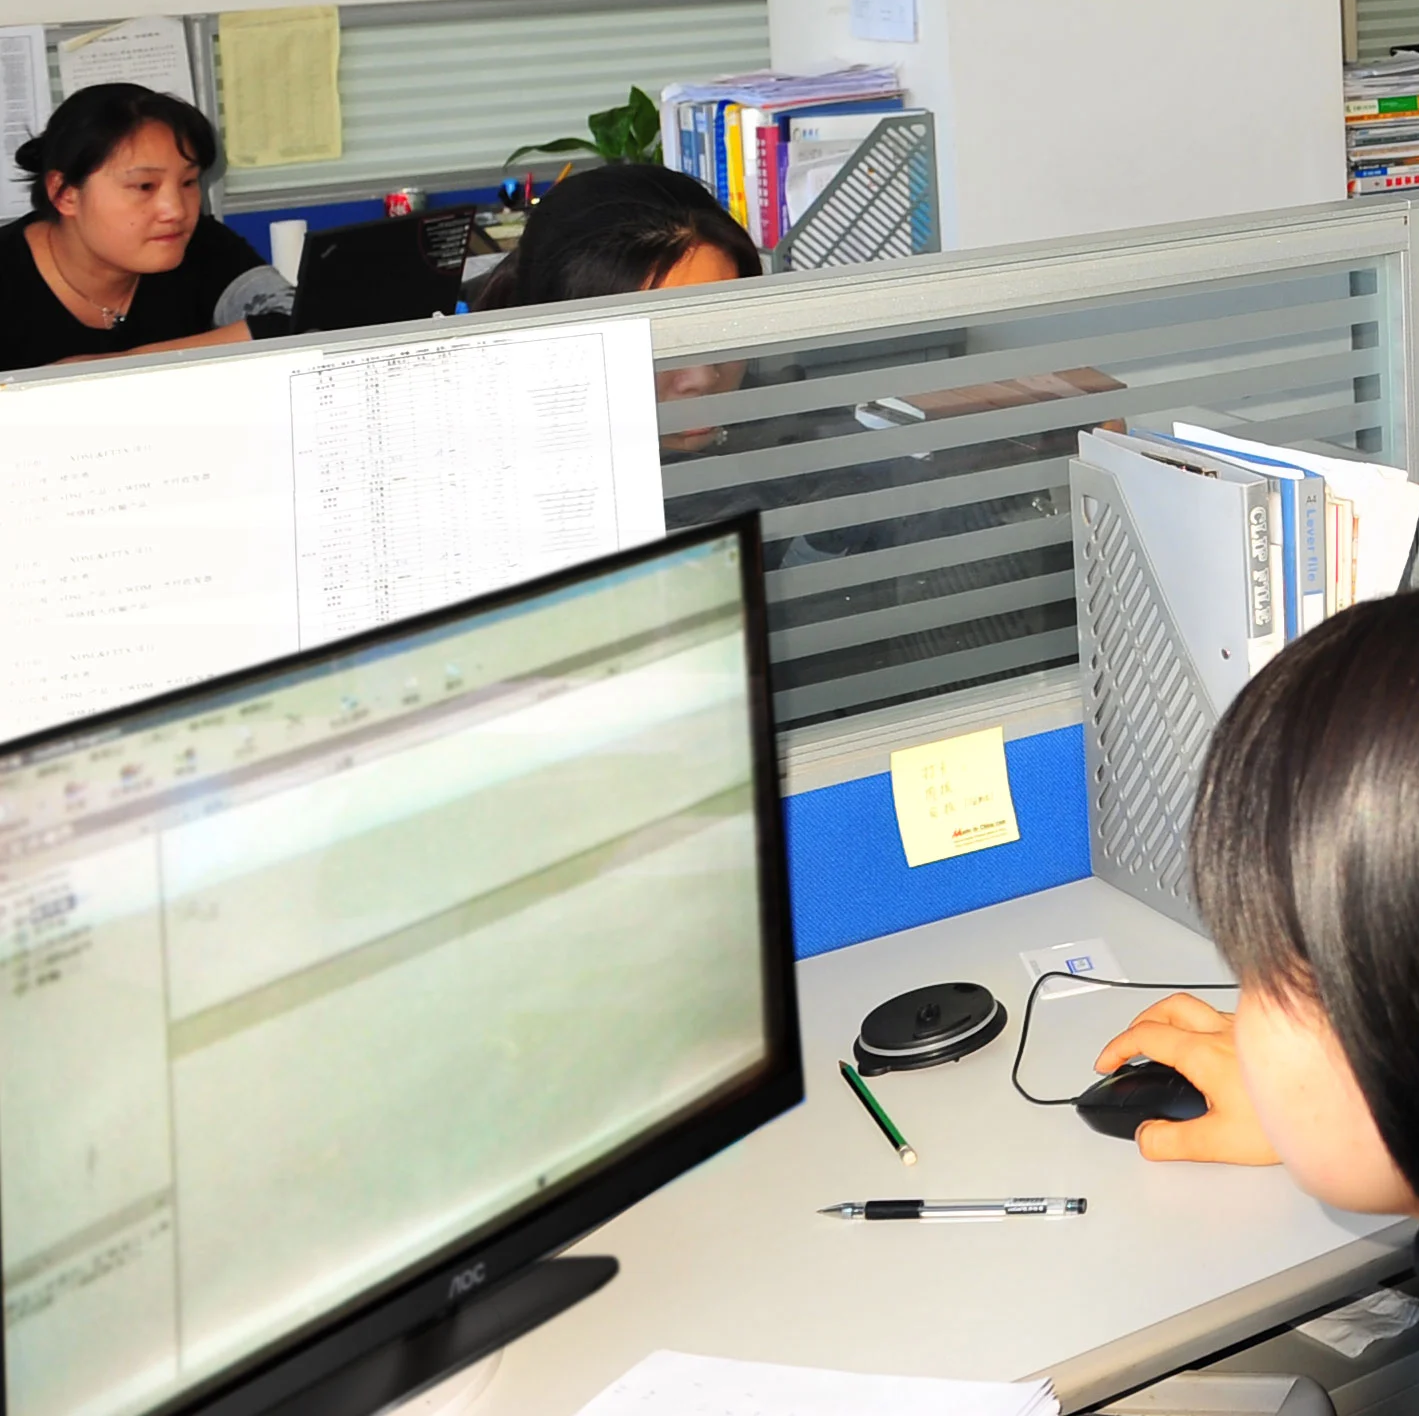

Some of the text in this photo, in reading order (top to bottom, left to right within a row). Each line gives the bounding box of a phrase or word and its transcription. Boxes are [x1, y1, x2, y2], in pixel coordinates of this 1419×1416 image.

[1306, 495, 1318, 504] A4
[1249, 506, 1271, 626] CLIP FILE
[1306, 509, 1318, 582] Lever file
[448, 1261, 486, 1300] AOC
